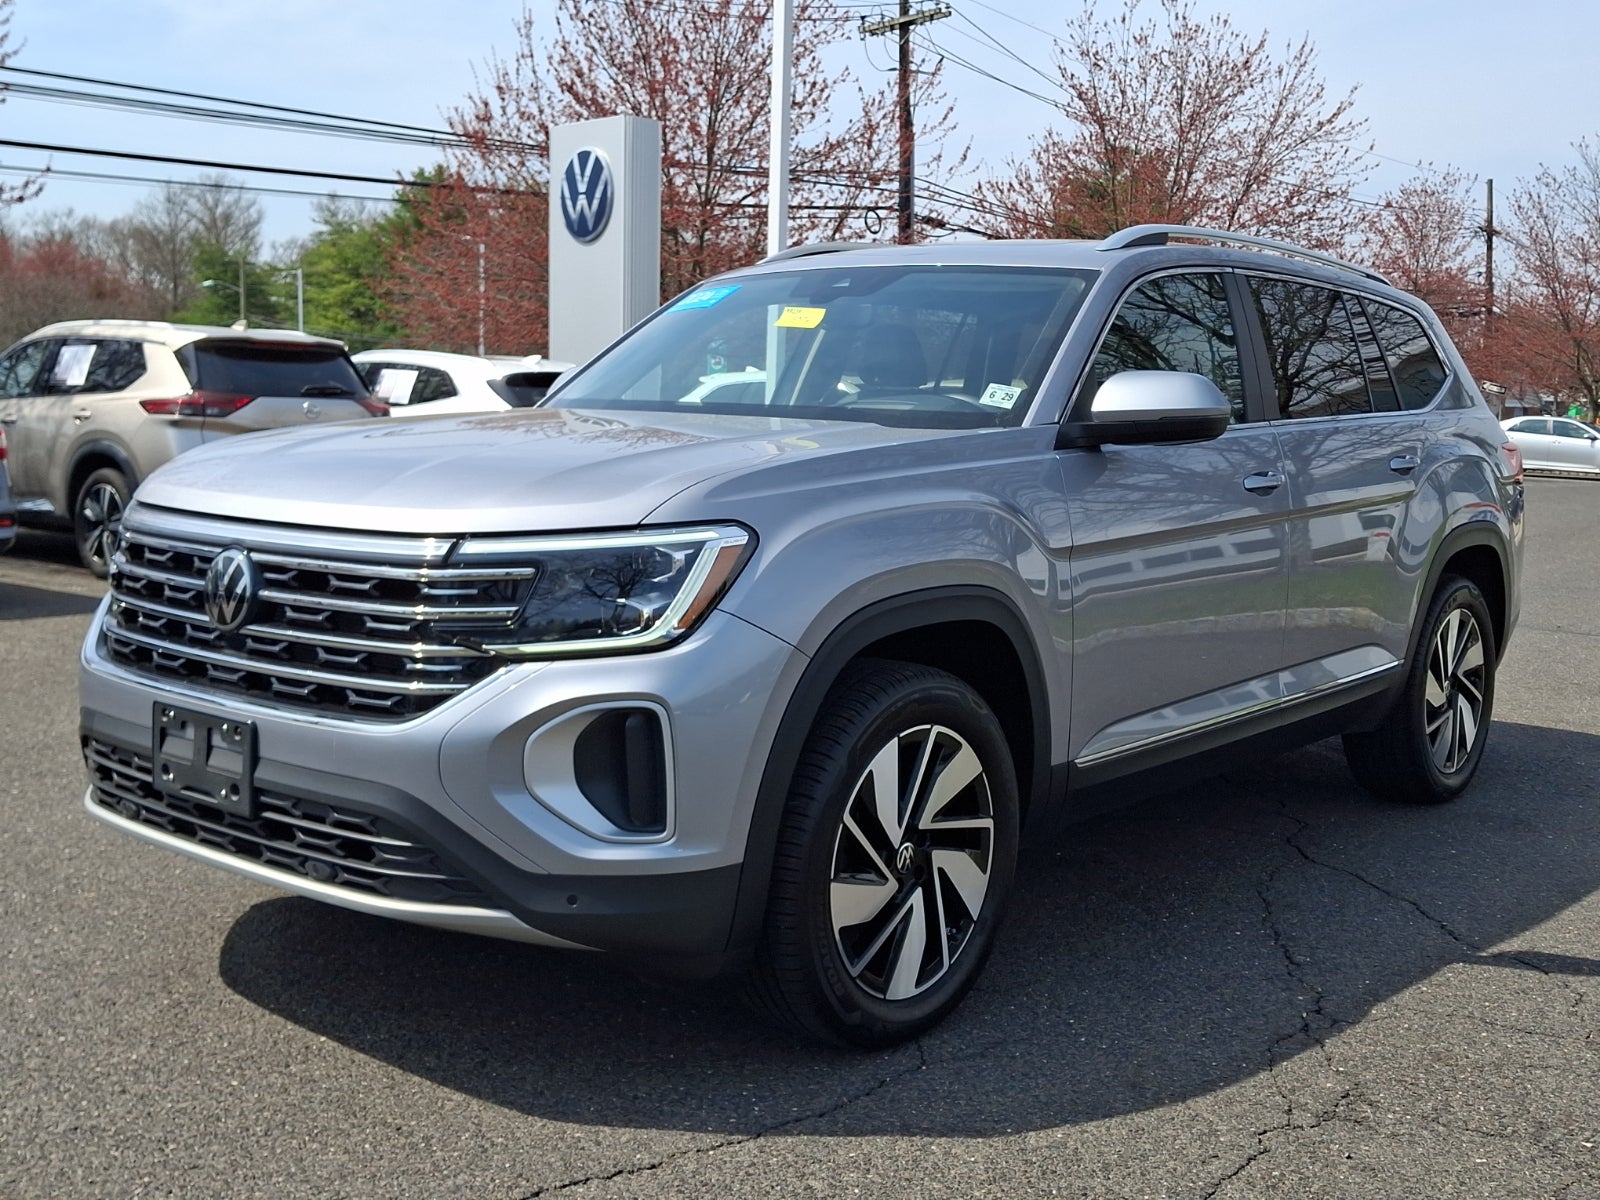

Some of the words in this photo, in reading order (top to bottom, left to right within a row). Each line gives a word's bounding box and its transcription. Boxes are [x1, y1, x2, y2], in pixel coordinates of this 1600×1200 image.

[561, 147, 611, 238] VW
[989, 390, 997, 399] 6
[1001, 392, 1014, 402] 29
[207, 549, 250, 628] VW
